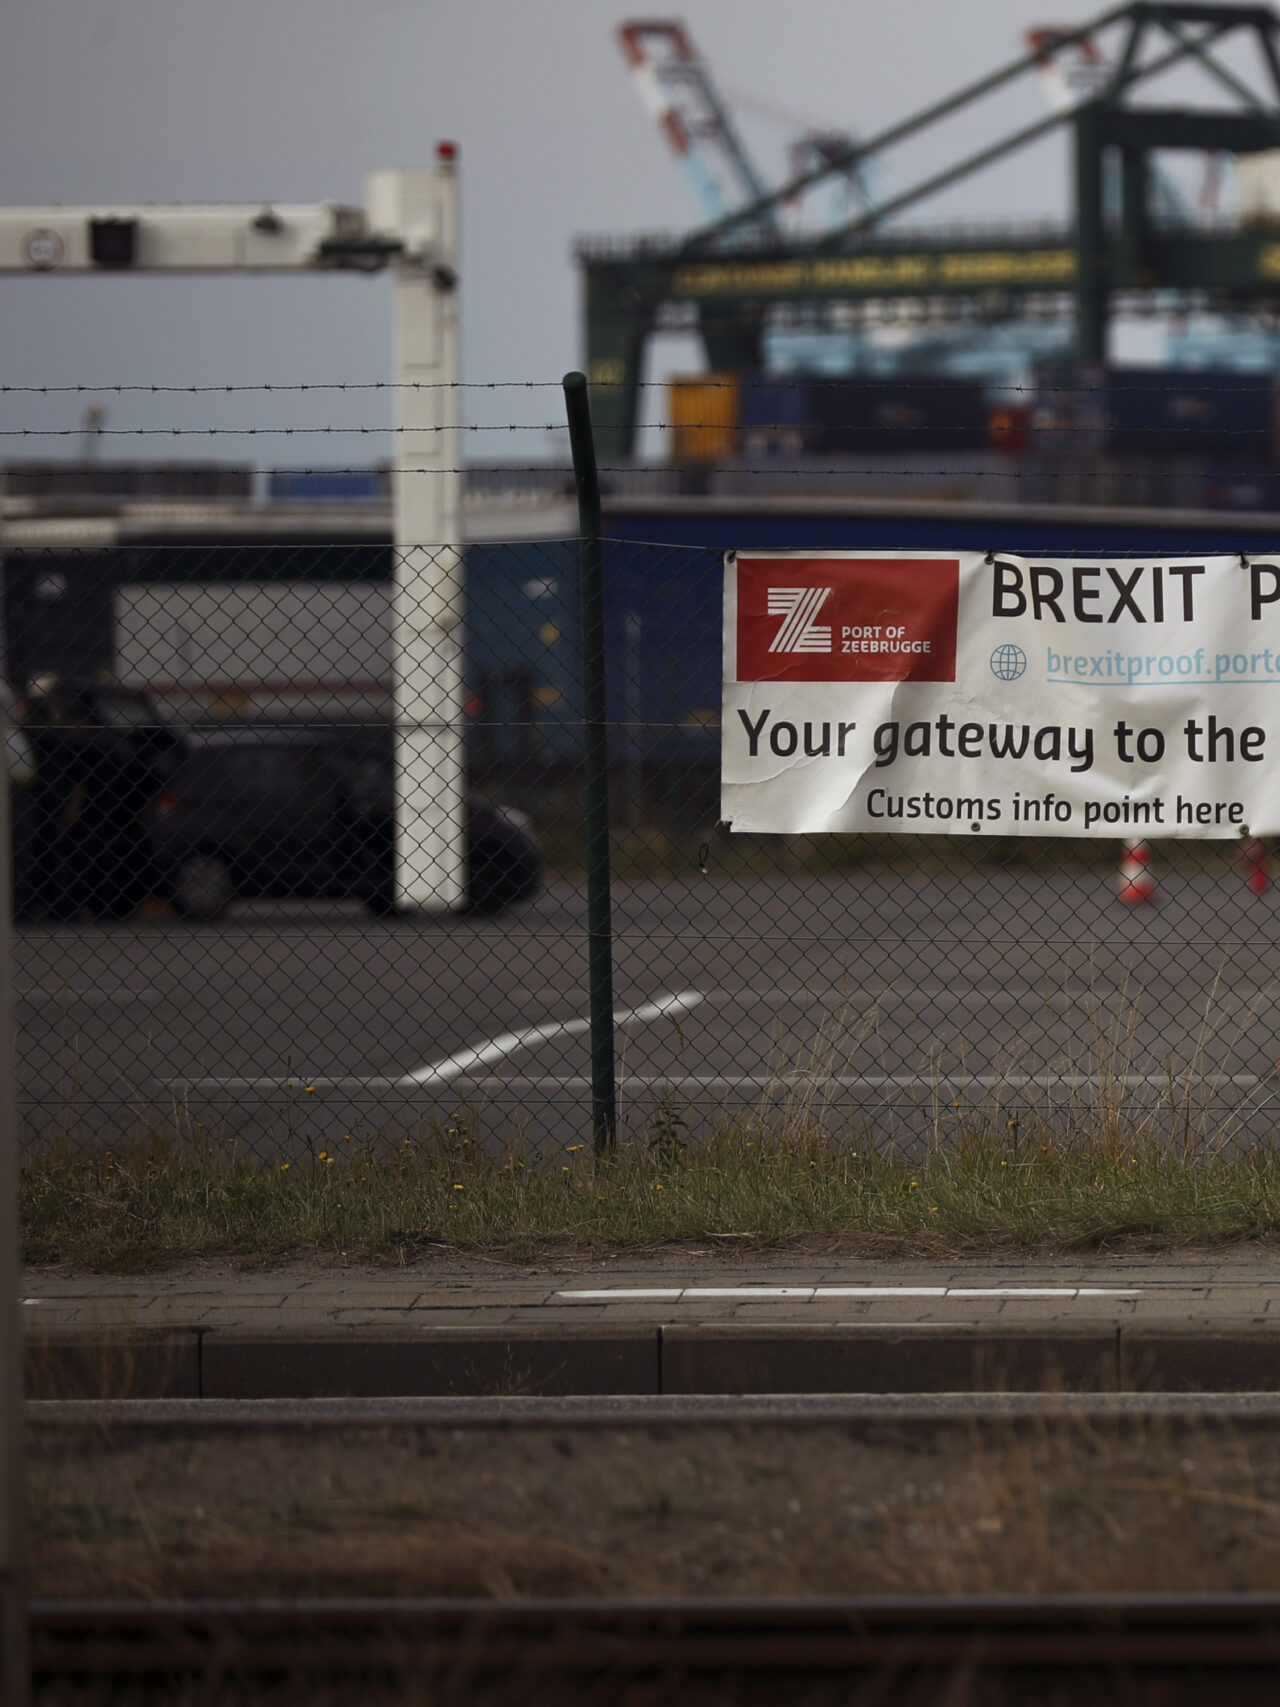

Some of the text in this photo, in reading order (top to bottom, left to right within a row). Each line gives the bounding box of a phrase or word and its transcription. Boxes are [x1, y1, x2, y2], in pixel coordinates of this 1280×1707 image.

[992, 562, 1206, 624] BREXIT
[841, 625, 906, 639] PORT OF
[841, 640, 932, 653] ZEEBRUGGE
[736, 709, 856, 758] Your
[872, 713, 1094, 773] gateway
[1113, 720, 1166, 763] to
[1183, 713, 1266, 763] the
[866, 788, 1244, 830] Customs info point here
